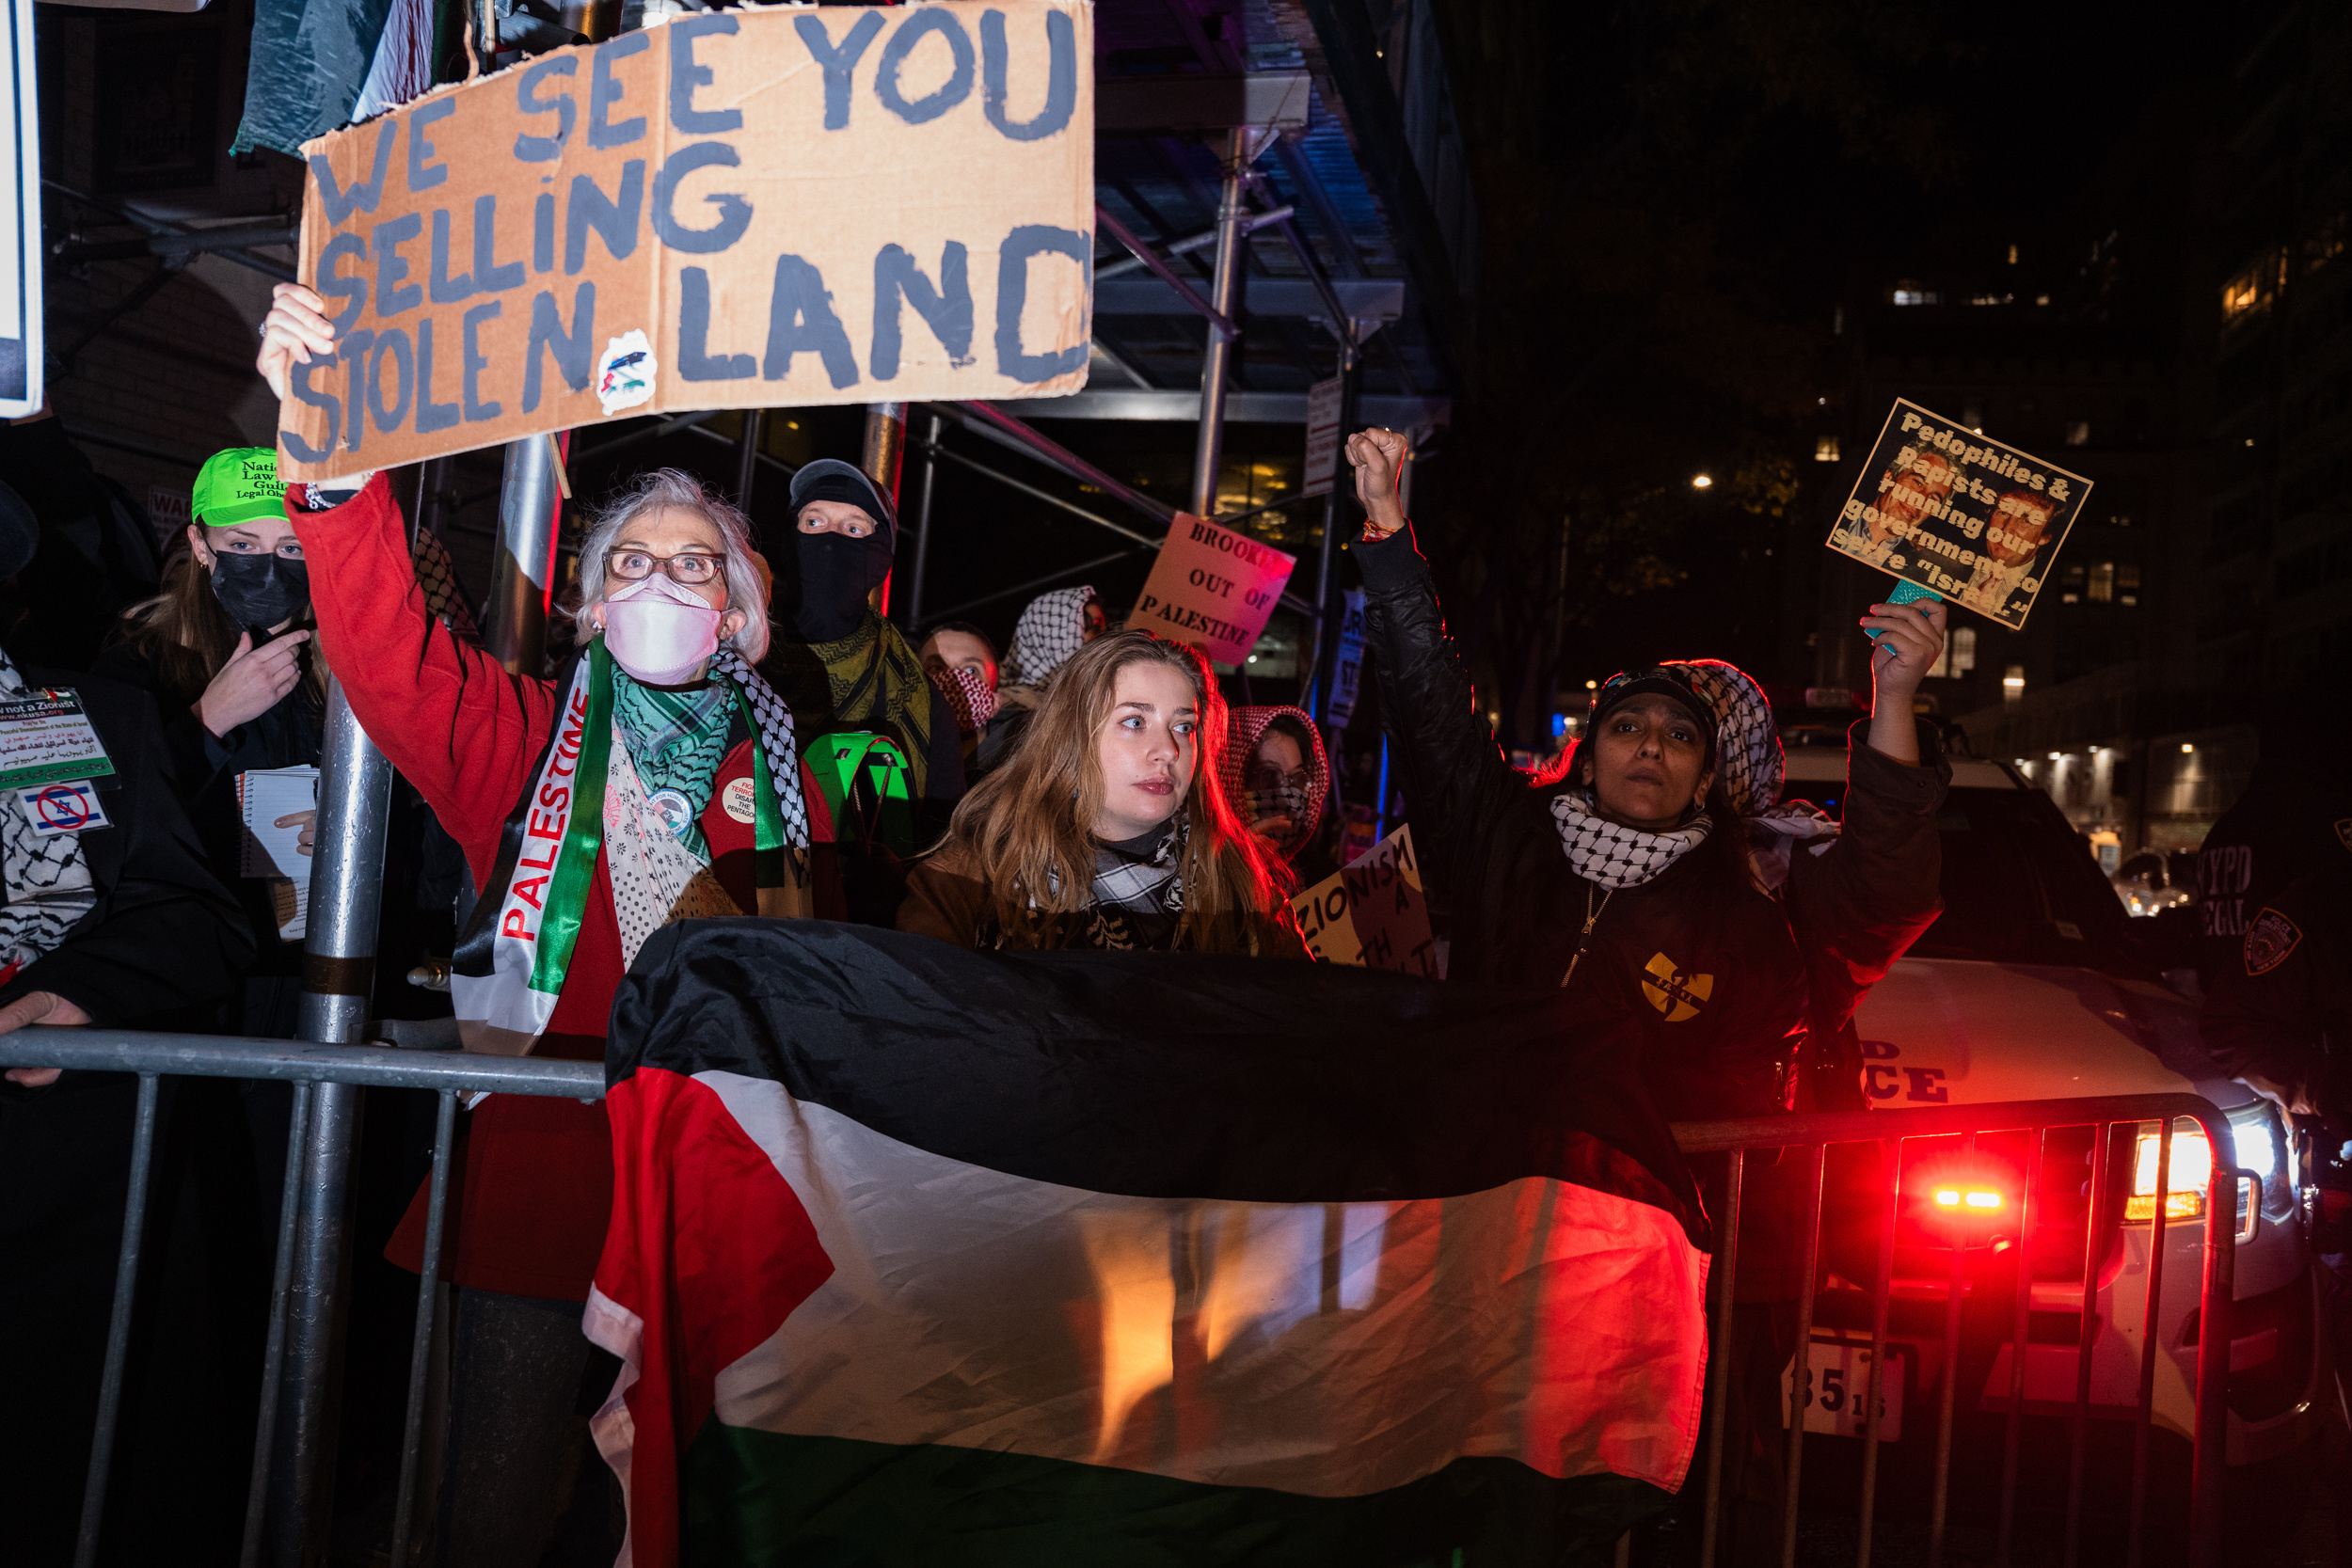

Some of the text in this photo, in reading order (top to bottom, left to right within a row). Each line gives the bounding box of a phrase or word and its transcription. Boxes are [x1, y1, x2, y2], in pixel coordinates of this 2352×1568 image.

[310, 8, 1077, 227] WE SEE YOU
[279, 224, 1091, 464] STOLEN LAND
[242, 461, 277, 471] Nati
[242, 470, 276, 481] Law
[1900, 411, 2070, 502] Pedophiles &
[236, 489, 284, 499] Legal Ob
[1894, 446, 2047, 526] Rapists are
[1844, 499, 2007, 578] government
[1878, 478, 2036, 555] running our
[1833, 528, 1908, 570] serve
[1189, 568, 1270, 610] OUT OF
[1140, 594, 1250, 647] PALESTINE
[6, 705, 26, 714] not
[27, 704, 36, 712] a
[35, 700, 76, 710] Zionist
[502, 687, 589, 942] PALESTINE
[736, 793, 755, 804] DISAR
[739, 801, 751, 810] THE
[1296, 834, 1413, 942] ZIONISM
